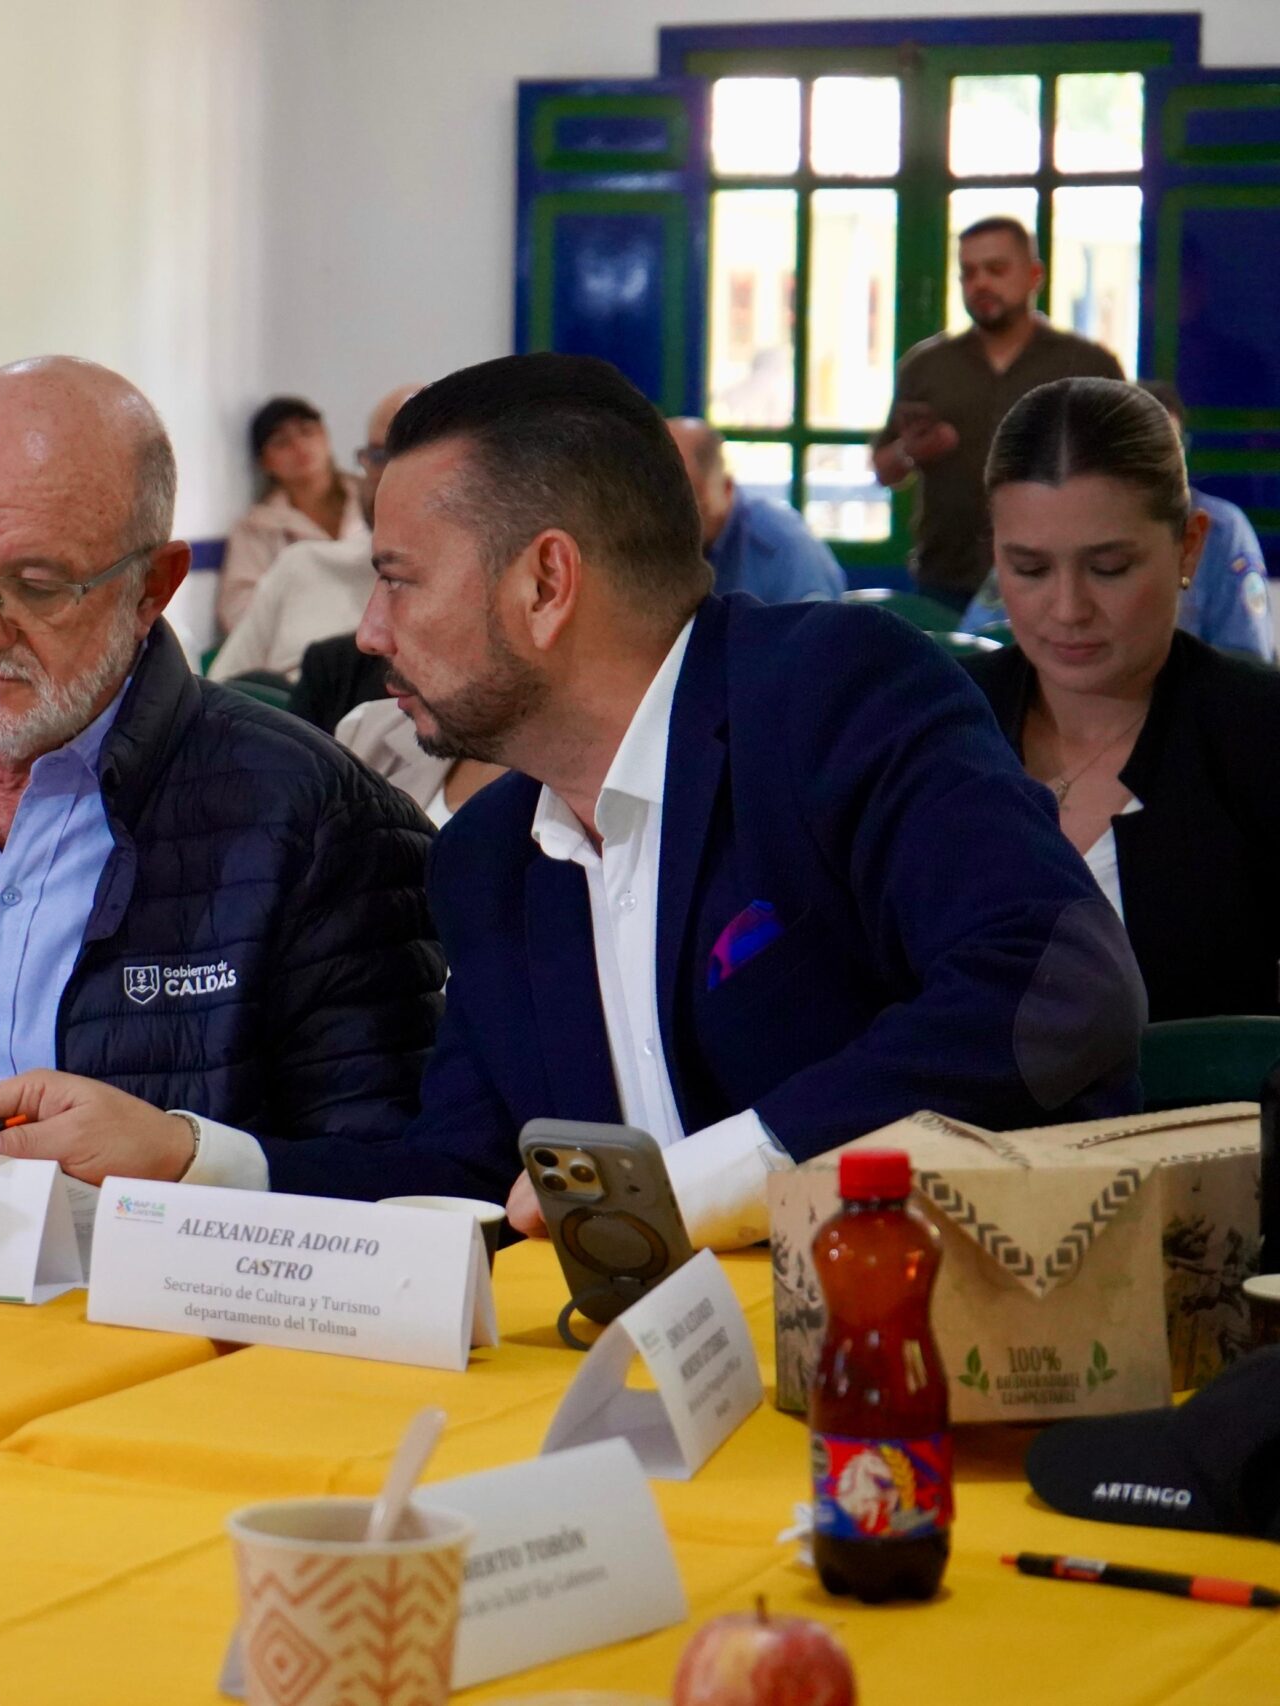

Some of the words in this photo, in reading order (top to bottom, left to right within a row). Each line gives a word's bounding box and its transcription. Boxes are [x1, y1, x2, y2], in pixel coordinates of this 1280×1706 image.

[163, 964, 216, 978] Gobierno
[165, 969, 237, 996] CALDAS
[177, 1218, 295, 1248] ALEXANDER
[297, 1232, 380, 1256] ADOLFO
[236, 1256, 313, 1281] CASTRO
[164, 1276, 232, 1298] Secretario
[235, 1285, 252, 1300] de
[255, 1287, 306, 1307] Cultura
[308, 1296, 318, 1312] y
[321, 1295, 381, 1316] Turismo
[184, 1303, 281, 1327] departamento
[283, 1315, 304, 1332] del
[308, 1317, 357, 1337] Tolima
[1007, 1346, 1062, 1373] 100%
[1092, 1482, 1192, 1509] ARTENGO
